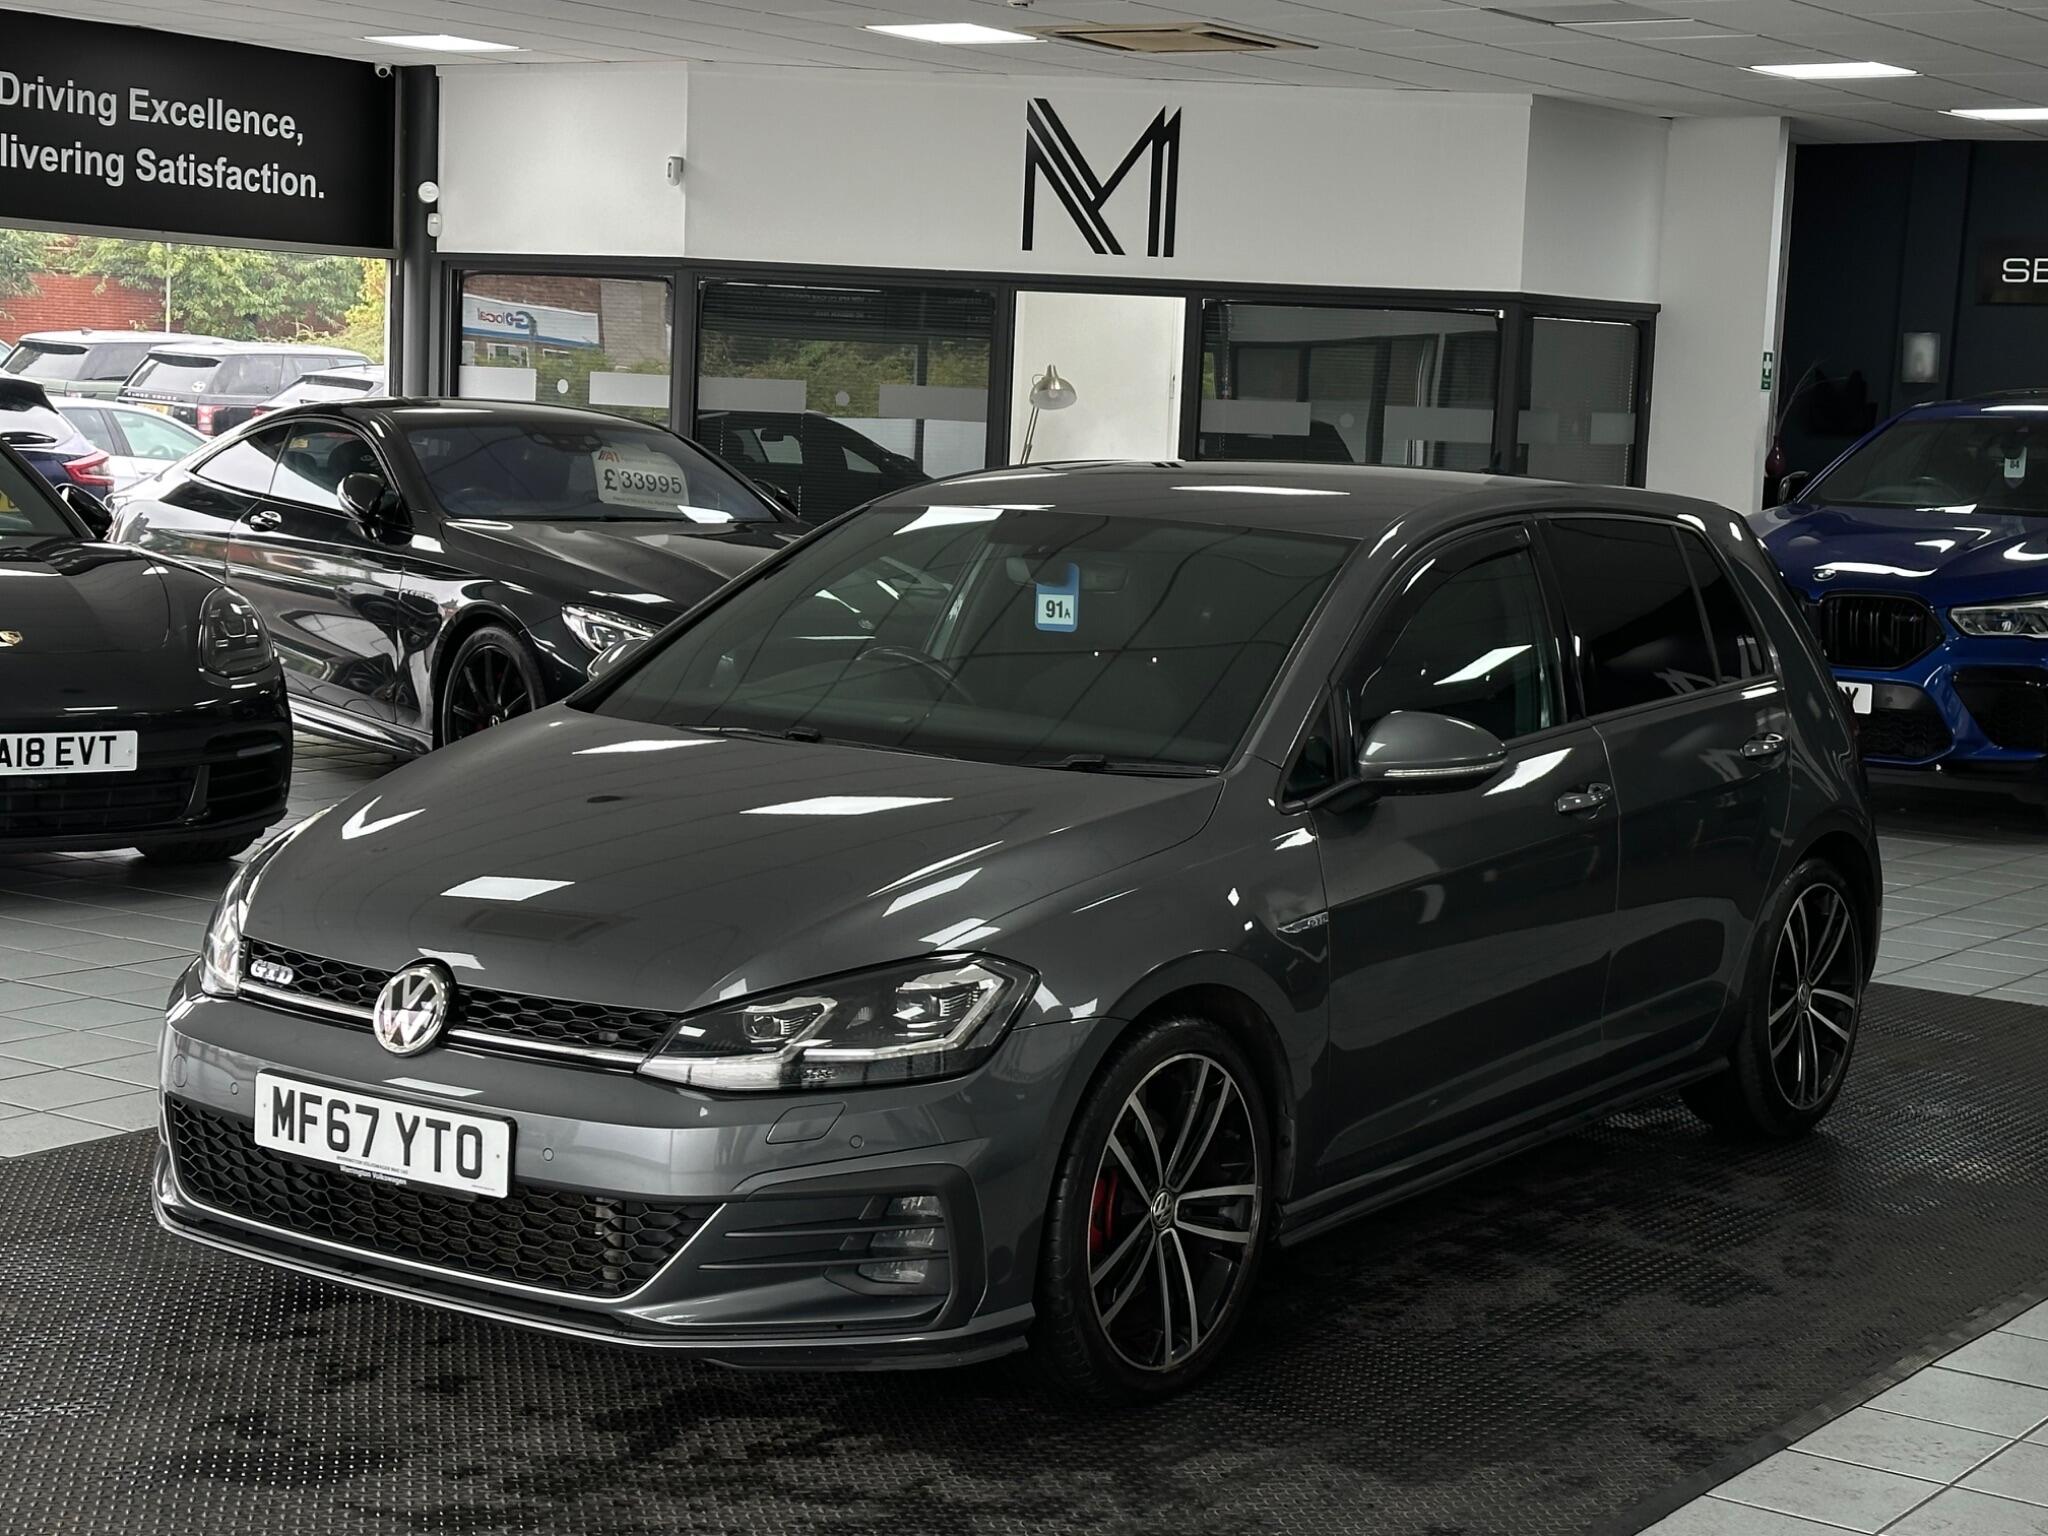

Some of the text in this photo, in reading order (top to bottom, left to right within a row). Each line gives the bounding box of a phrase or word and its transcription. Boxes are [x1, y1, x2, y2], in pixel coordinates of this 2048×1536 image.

[0, 71, 303, 146] Driving Excellence,
[0, 133, 325, 199] livering Satisfaction.
[604, 468, 682, 494] £33995
[56, 735, 117, 766] EVT
[251, 959, 293, 985] GTD
[272, 1085, 483, 1180] MF67 YTO
